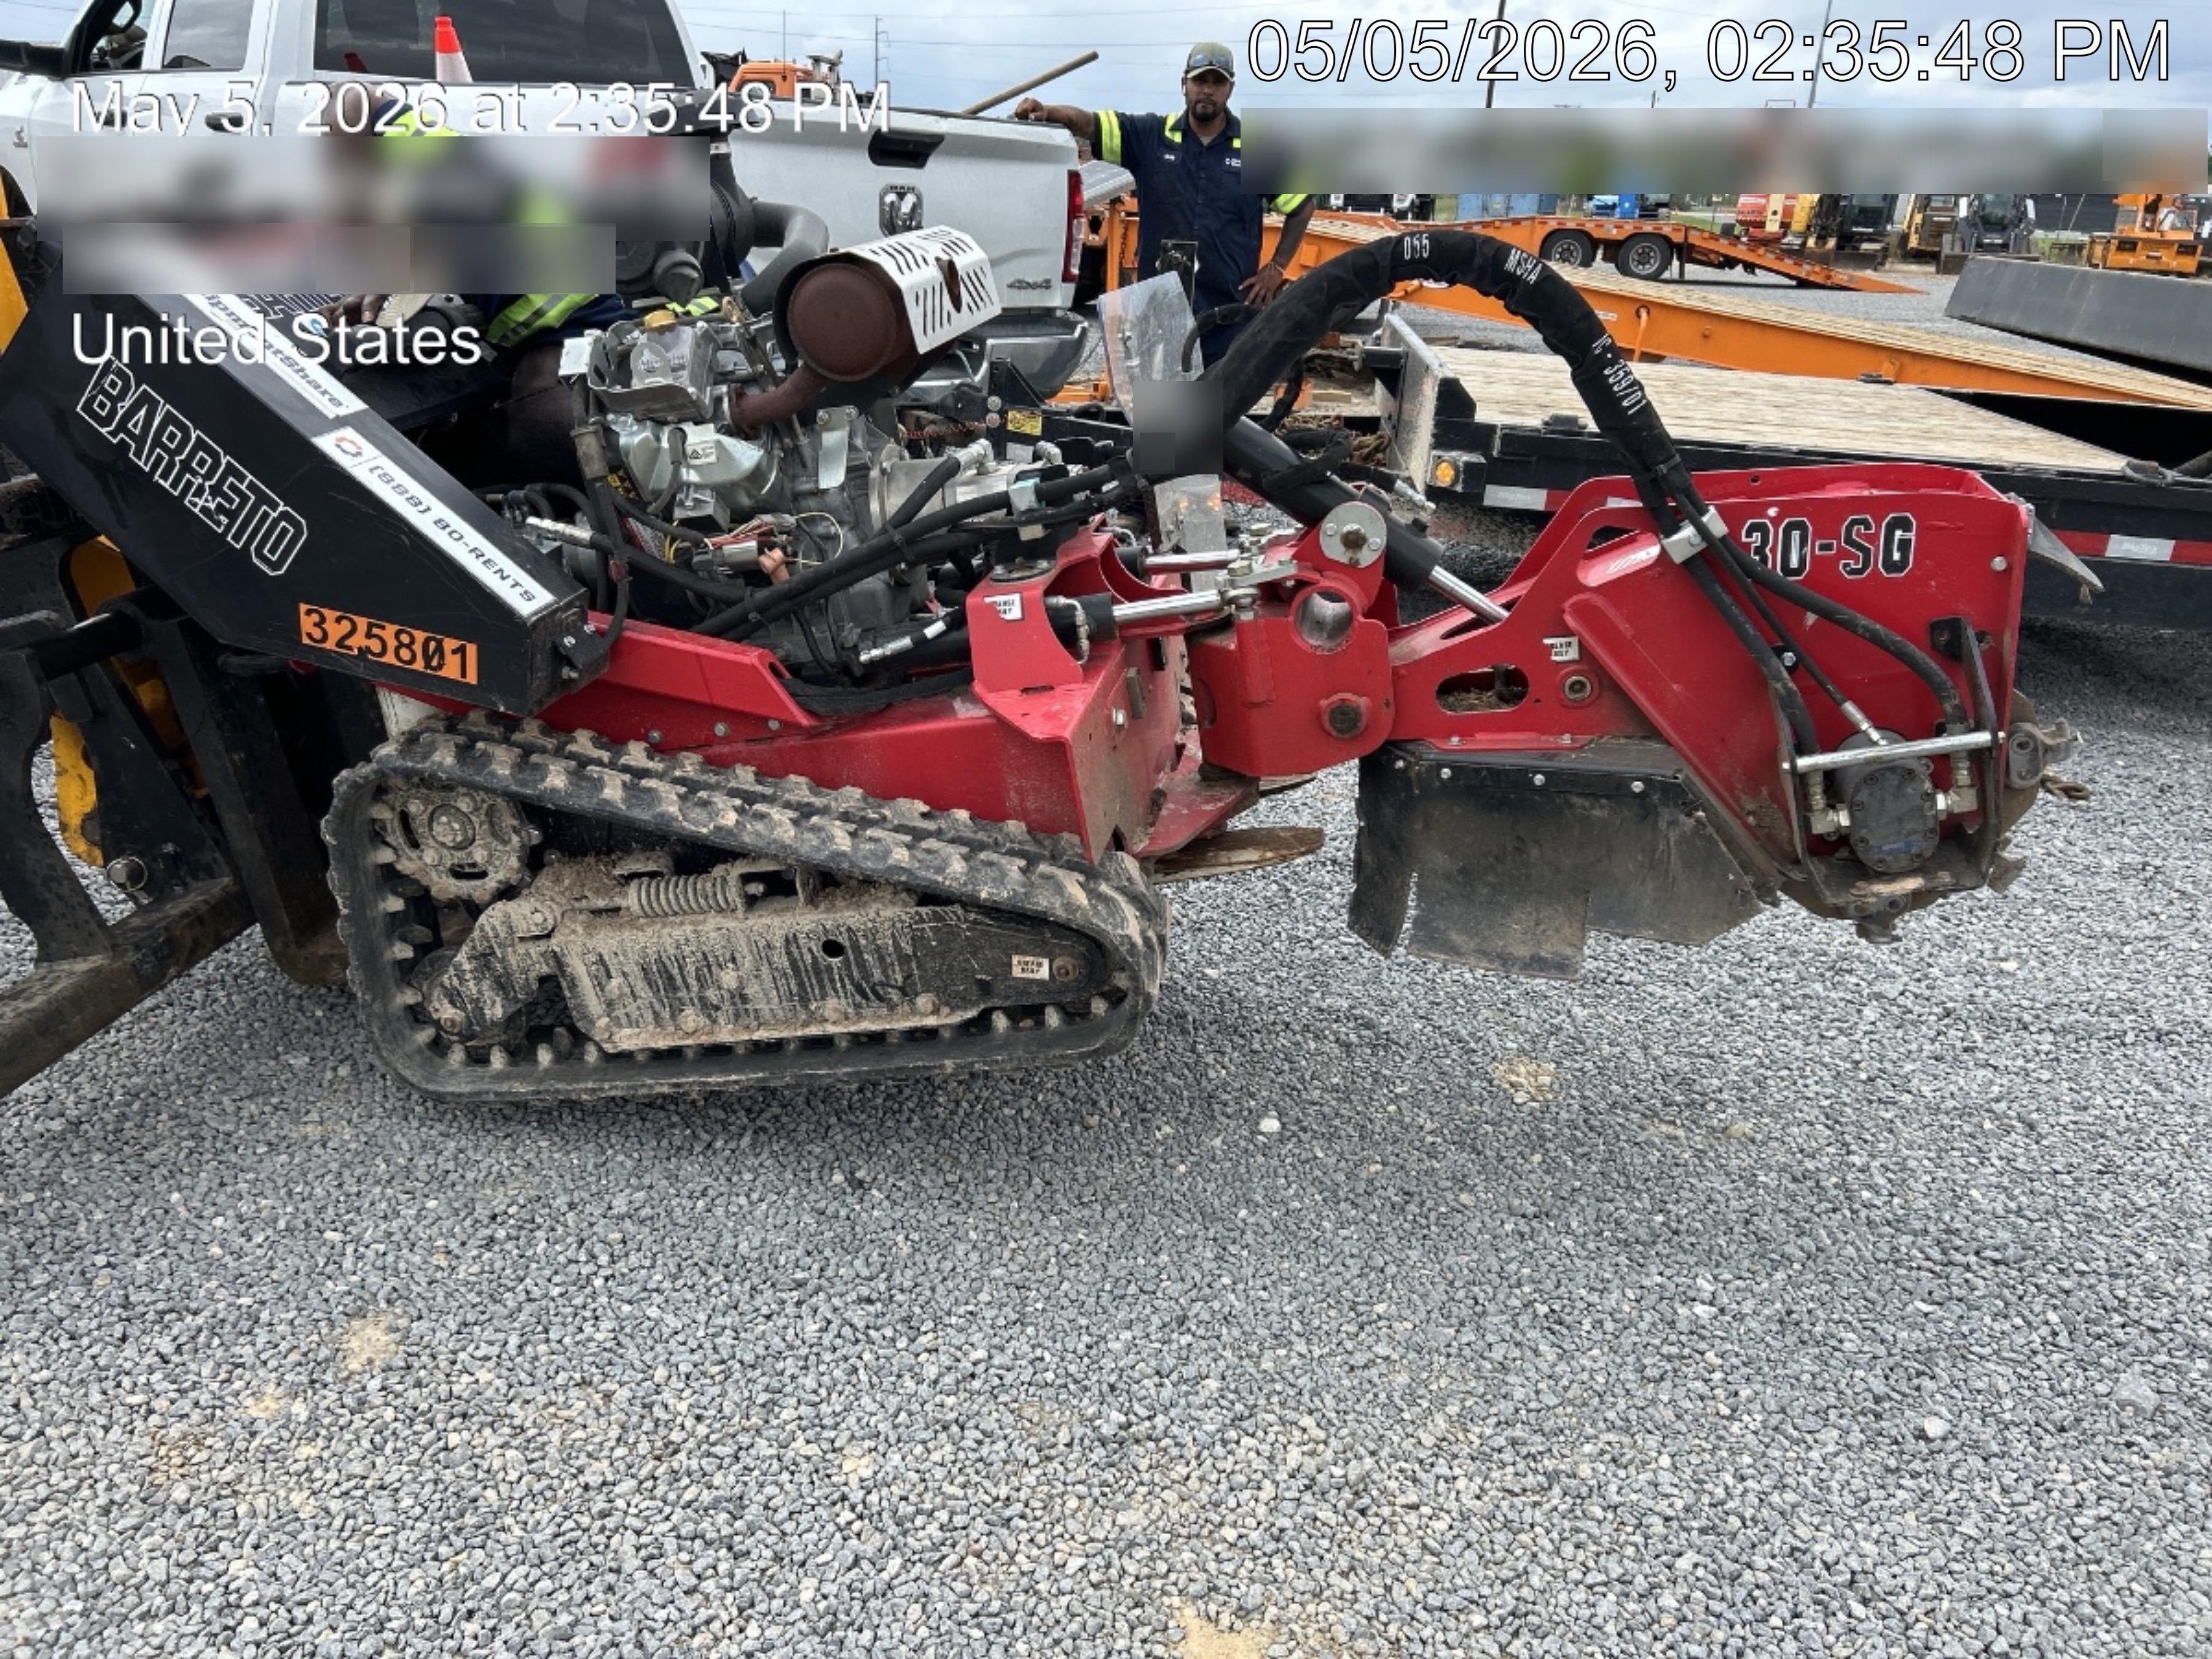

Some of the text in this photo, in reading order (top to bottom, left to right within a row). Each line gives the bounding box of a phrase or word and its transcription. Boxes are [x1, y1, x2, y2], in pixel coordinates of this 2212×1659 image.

[1504, 248, 1543, 284] MSHA
[76, 355, 307, 576] BARRETO
[369, 465, 536, 602] (888) 80-RENTS
[1741, 512, 1916, 580] 30-SG
[304, 608, 468, 680] 325801
